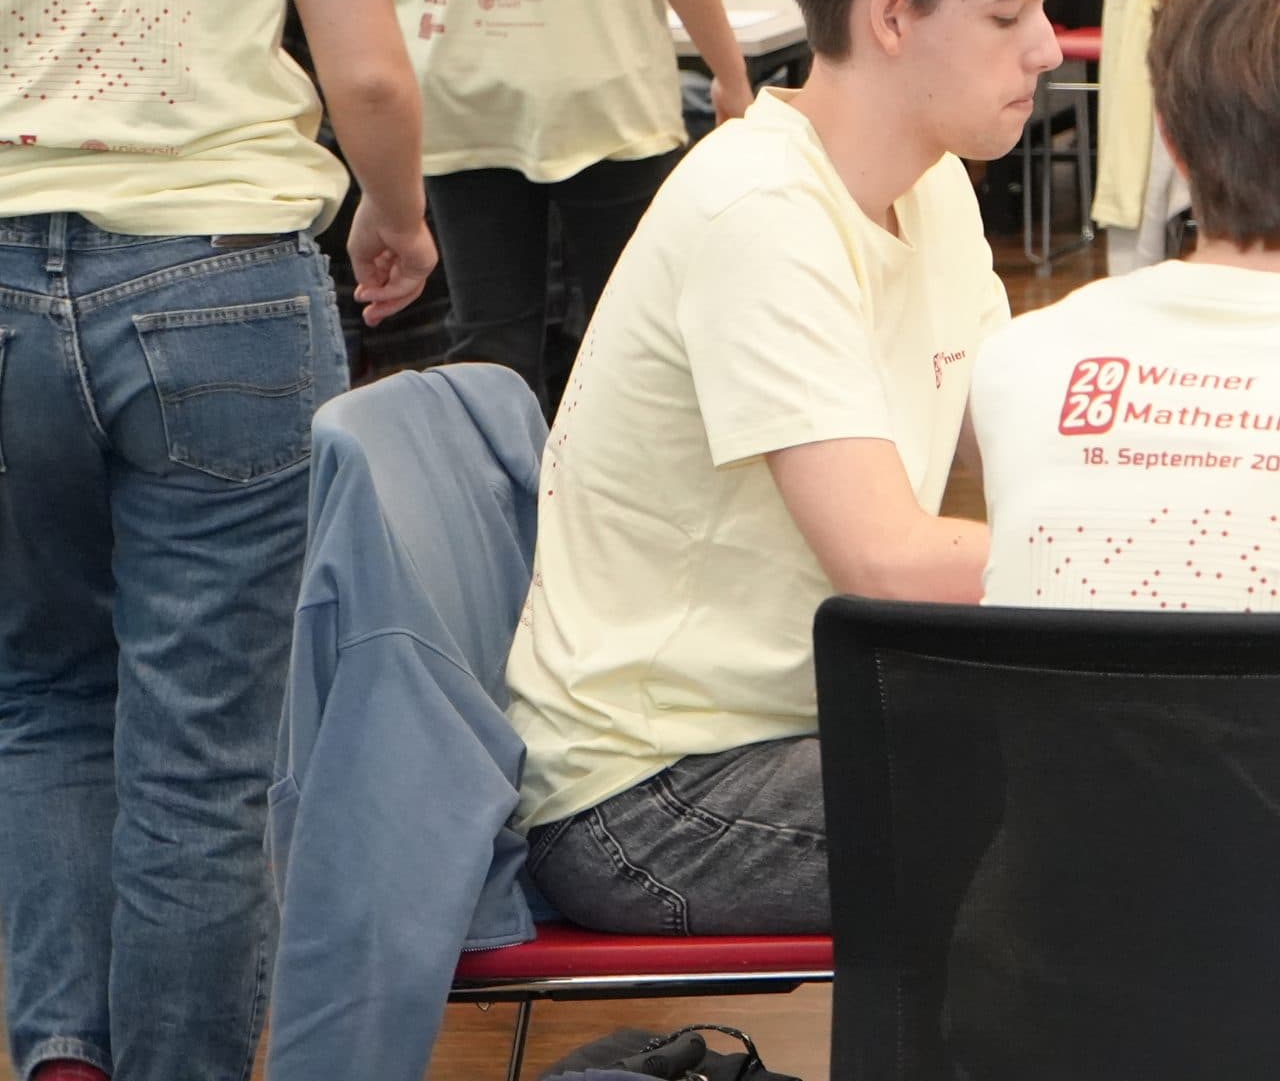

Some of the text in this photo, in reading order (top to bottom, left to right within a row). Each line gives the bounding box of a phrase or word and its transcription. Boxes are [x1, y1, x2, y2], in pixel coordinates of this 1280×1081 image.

[1071, 361, 1126, 393] 20
[1137, 365, 1258, 391] Wiener
[1062, 393, 1114, 428] 26
[1083, 447, 1109, 465] 18.
[1118, 448, 1243, 470] September
